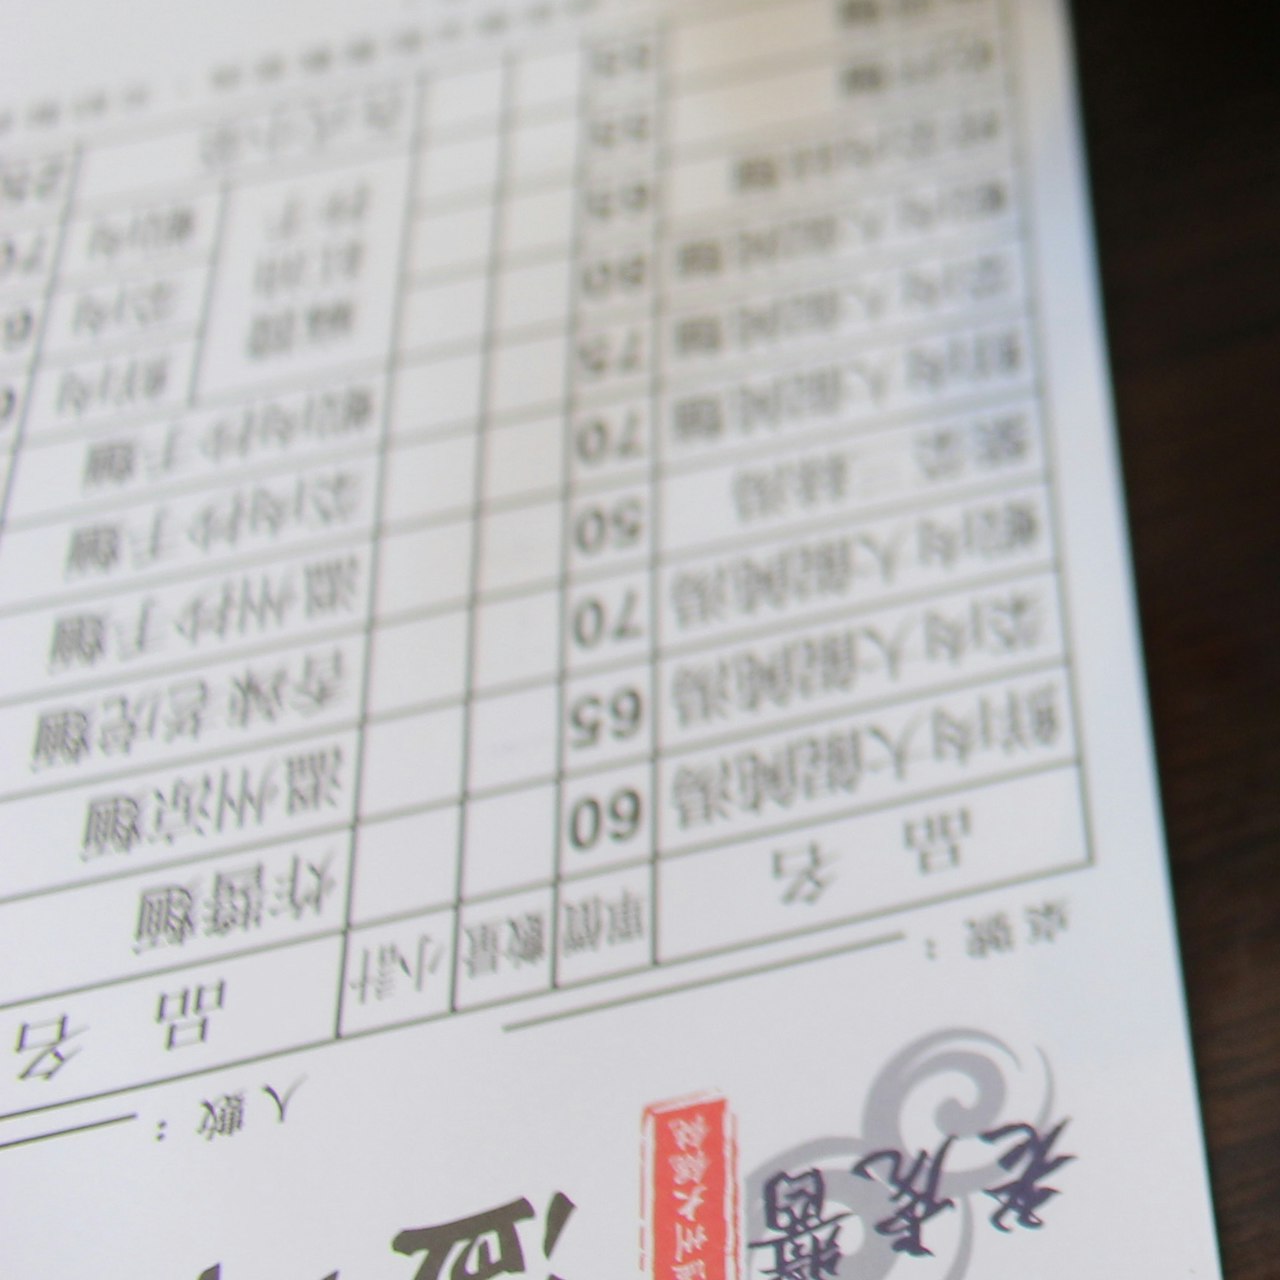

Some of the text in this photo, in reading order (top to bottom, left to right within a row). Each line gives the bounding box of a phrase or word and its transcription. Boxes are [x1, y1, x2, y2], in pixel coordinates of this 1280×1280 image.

[575, 414, 642, 468] 70
[574, 500, 641, 555] 50
[573, 592, 638, 649] 70
[568, 687, 643, 750] 65
[569, 788, 642, 852] 60
[132, 853, 333, 955] 炸醬麵
[562, 889, 644, 958] 單價
[349, 935, 442, 1004] 小計
[462, 912, 546, 979] 數量
